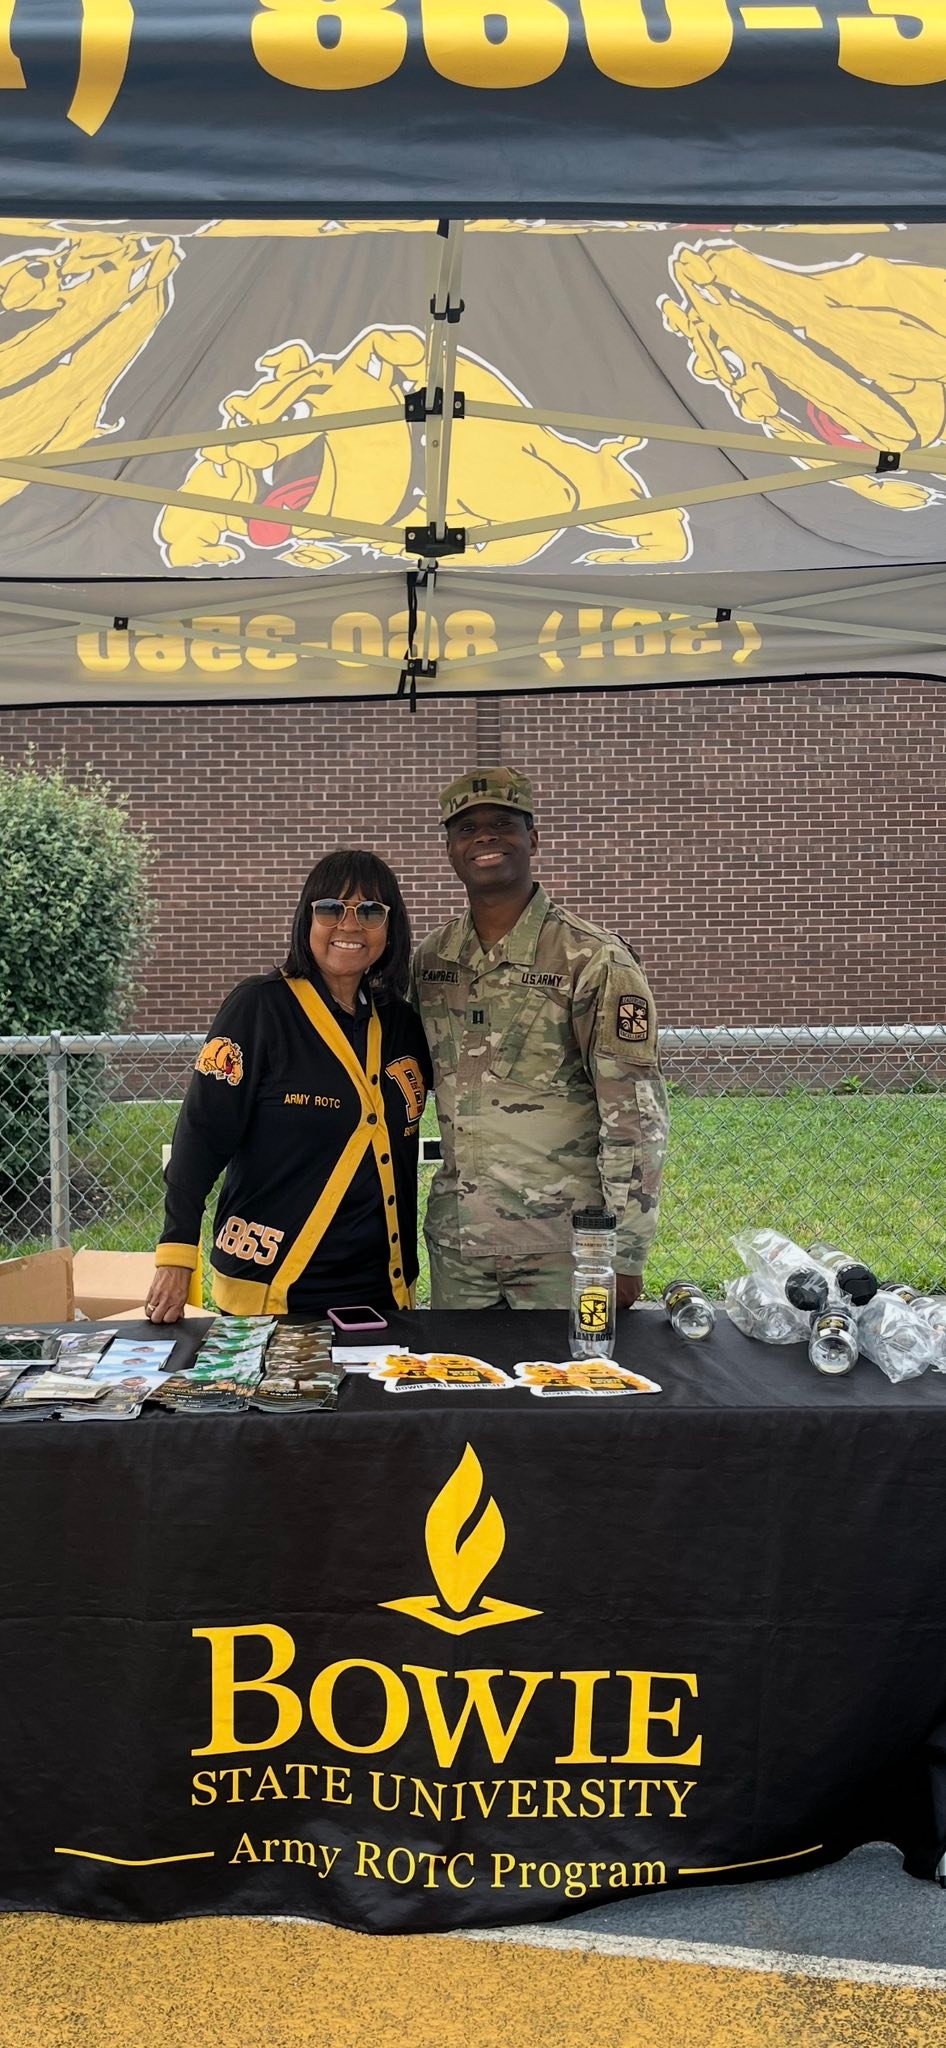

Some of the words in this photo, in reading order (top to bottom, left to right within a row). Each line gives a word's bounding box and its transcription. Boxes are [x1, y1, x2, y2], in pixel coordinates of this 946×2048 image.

[284, 1093, 310, 1105] ARMY
[314, 1096, 341, 1109] ROTC
[191, 1623, 702, 1768] BOWIE
[192, 1766, 352, 1806] STATE
[370, 1772, 697, 1821] UNIVERSITY
[228, 1832, 342, 1880] Army
[354, 1839, 476, 1889] ROTC
[491, 1853, 668, 1898] Program
